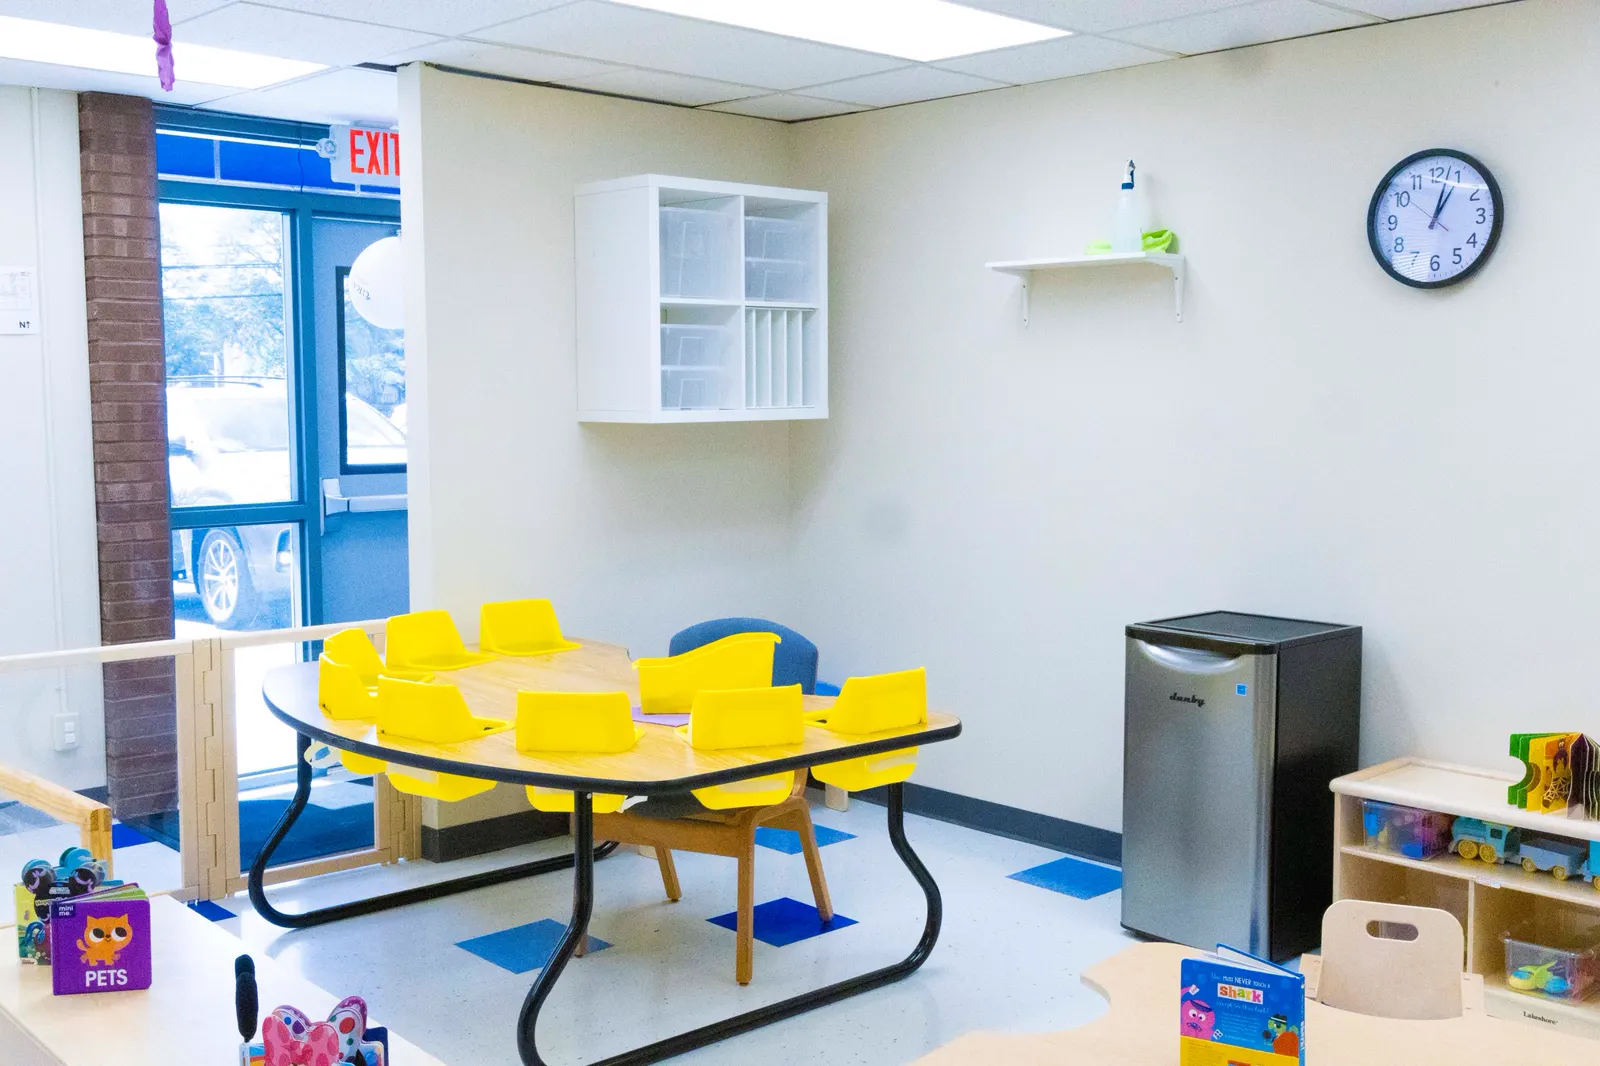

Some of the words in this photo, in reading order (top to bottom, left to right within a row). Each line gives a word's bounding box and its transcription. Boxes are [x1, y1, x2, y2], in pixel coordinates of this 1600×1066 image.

[349, 128, 400, 176] EXIT
[1410, 174, 1422, 190] 11
[1428, 166, 1445, 184] 12
[1454, 170, 1461, 183] 1
[1393, 190, 1411, 208] 10
[1469, 184, 1480, 202] 2
[1387, 214, 1398, 231] 9
[1475, 207, 1486, 224] 3
[1393, 236, 1404, 253] 8
[1466, 232, 1478, 248] 4
[1409, 251, 1420, 266] 7
[1430, 254, 1440, 271] 6
[1452, 247, 1462, 264] 5
[19, 321, 26, 329] N
[1169, 692, 1206, 708] danby
[85, 968, 128, 987] PETS
[1234, 976, 1252, 986] NEVER
[1219, 985, 1262, 1003] shark
[1523, 1011, 1557, 1025] Lakeshore
